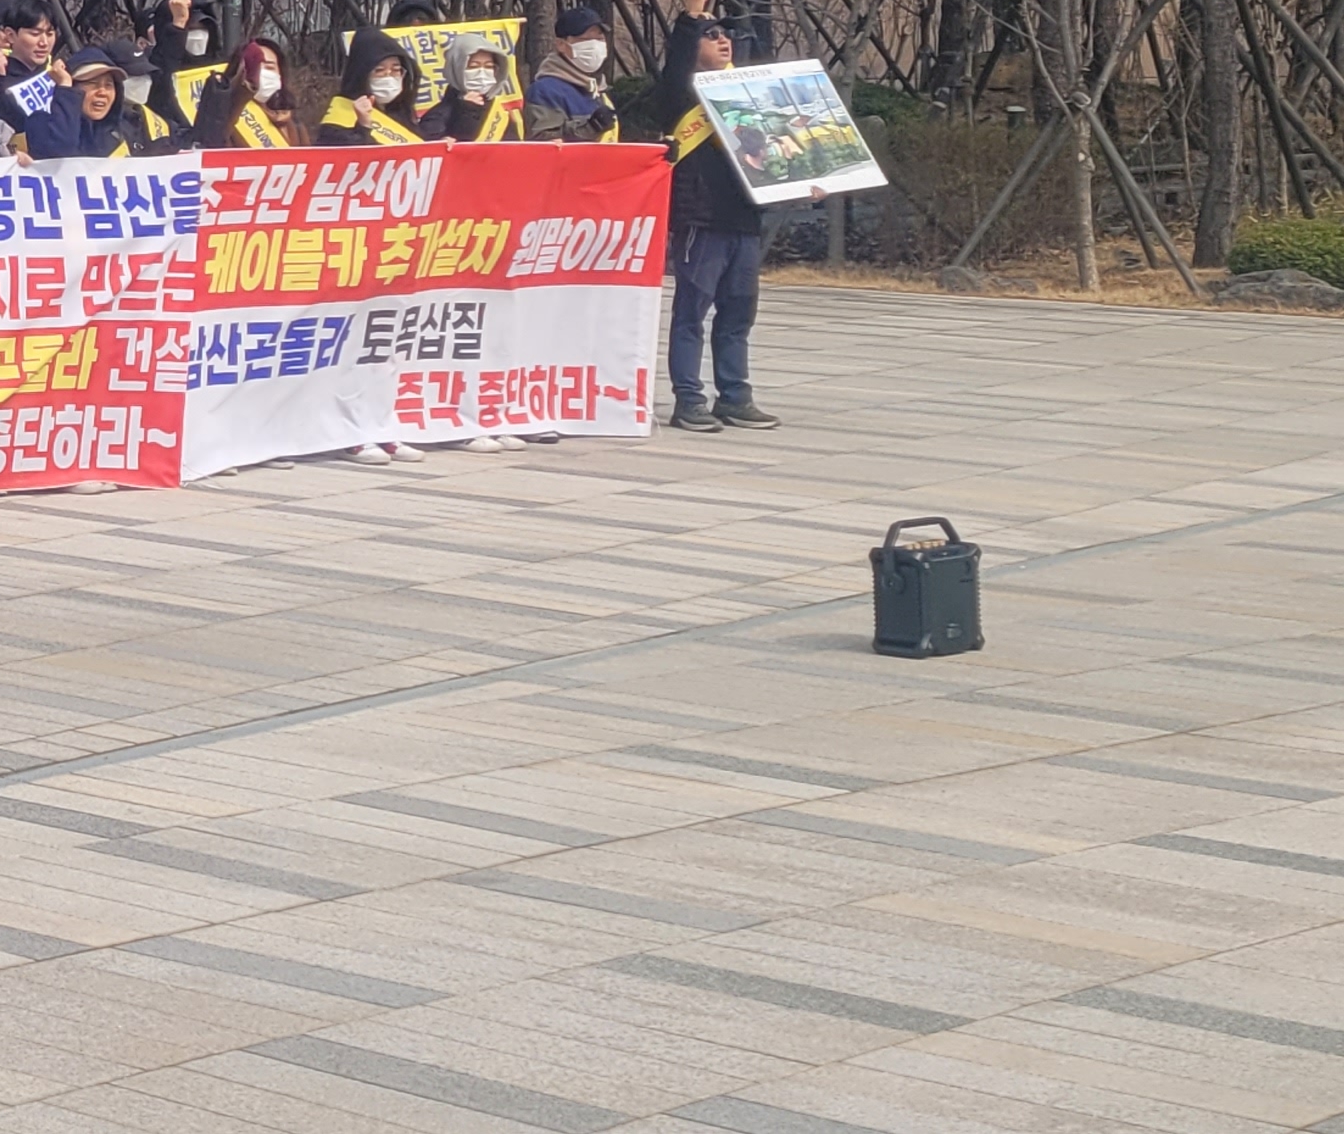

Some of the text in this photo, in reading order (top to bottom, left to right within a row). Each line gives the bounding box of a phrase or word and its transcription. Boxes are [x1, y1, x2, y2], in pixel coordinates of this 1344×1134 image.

[75, 171, 202, 239] 남산을
[199, 156, 443, 226] 조그만 남산에
[80, 249, 196, 316] 만드는
[204, 216, 657, 294] 케이블카 추가설치 웬말이냐!
[107, 327, 189, 393] 건설
[186, 302, 487, 390] 남산곤돌라 토목삽질
[393, 365, 649, 430] 즉각 중단하라~!
